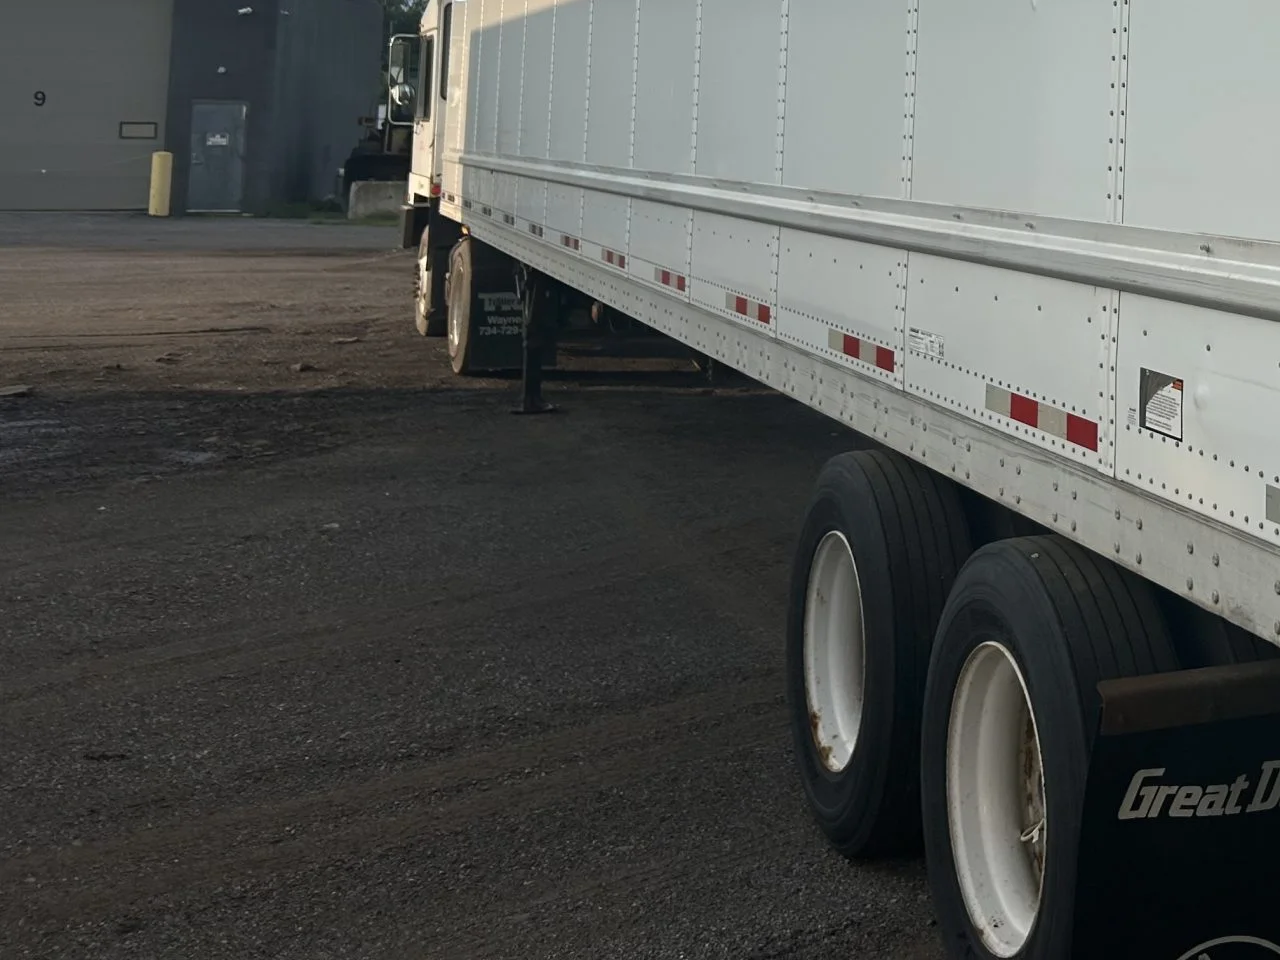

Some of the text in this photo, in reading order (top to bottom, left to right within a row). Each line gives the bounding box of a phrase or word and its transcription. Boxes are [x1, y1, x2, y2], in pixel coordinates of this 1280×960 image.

[34, 90, 46, 106] 9
[479, 326, 523, 336] 734-729-
[1118, 768, 1249, 820] Great
